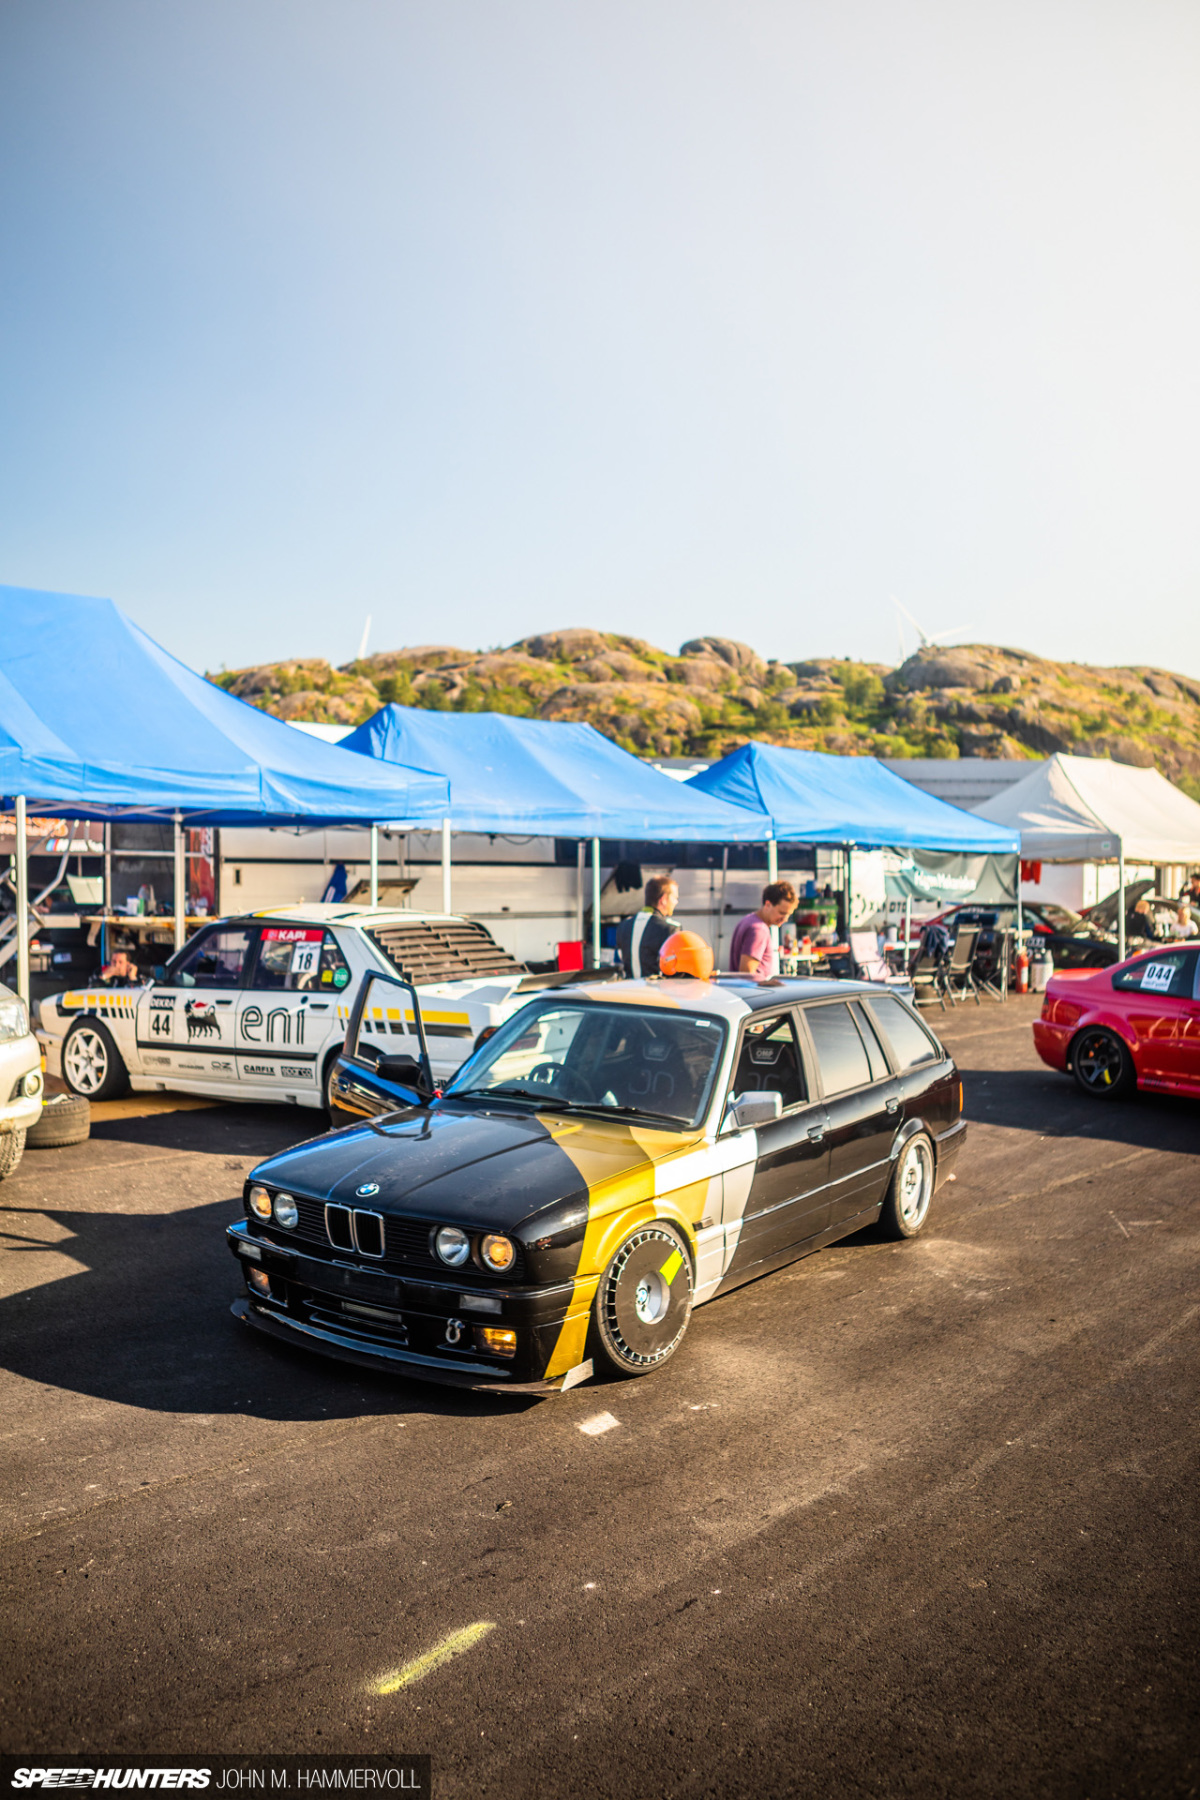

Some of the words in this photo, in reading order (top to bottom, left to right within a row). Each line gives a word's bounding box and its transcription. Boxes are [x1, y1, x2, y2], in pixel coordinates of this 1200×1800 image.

[279, 930, 306, 940] KAPI
[298, 952, 313, 971] 18
[1147, 965, 1172, 981] 044
[151, 997, 175, 1008] DEKRA
[152, 1014, 171, 1036] 44
[240, 995, 309, 1045] eni
[243, 1065, 275, 1073] CARFIX
